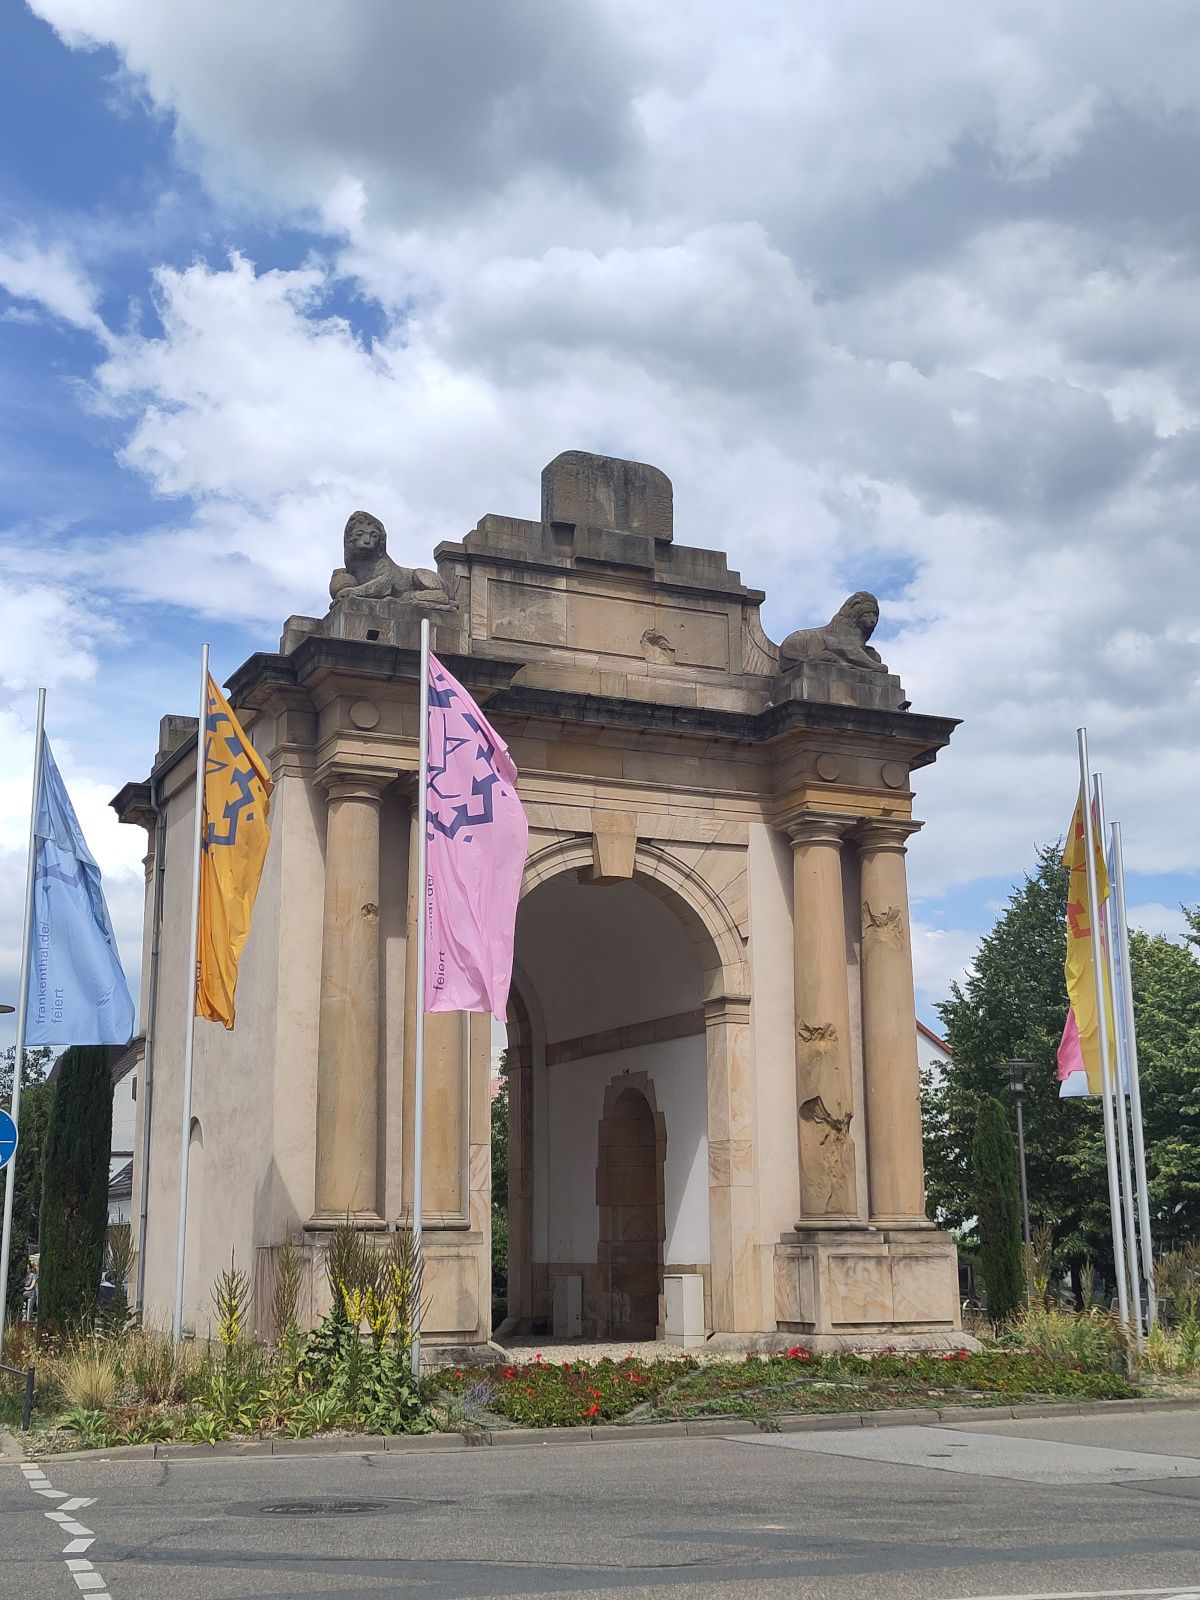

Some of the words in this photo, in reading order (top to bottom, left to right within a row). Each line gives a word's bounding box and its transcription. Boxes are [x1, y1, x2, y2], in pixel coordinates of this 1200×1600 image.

[35, 921, 50, 1024] frankenthal.de/
[433, 950, 445, 991] feiert
[51, 988, 64, 1024] feiert
